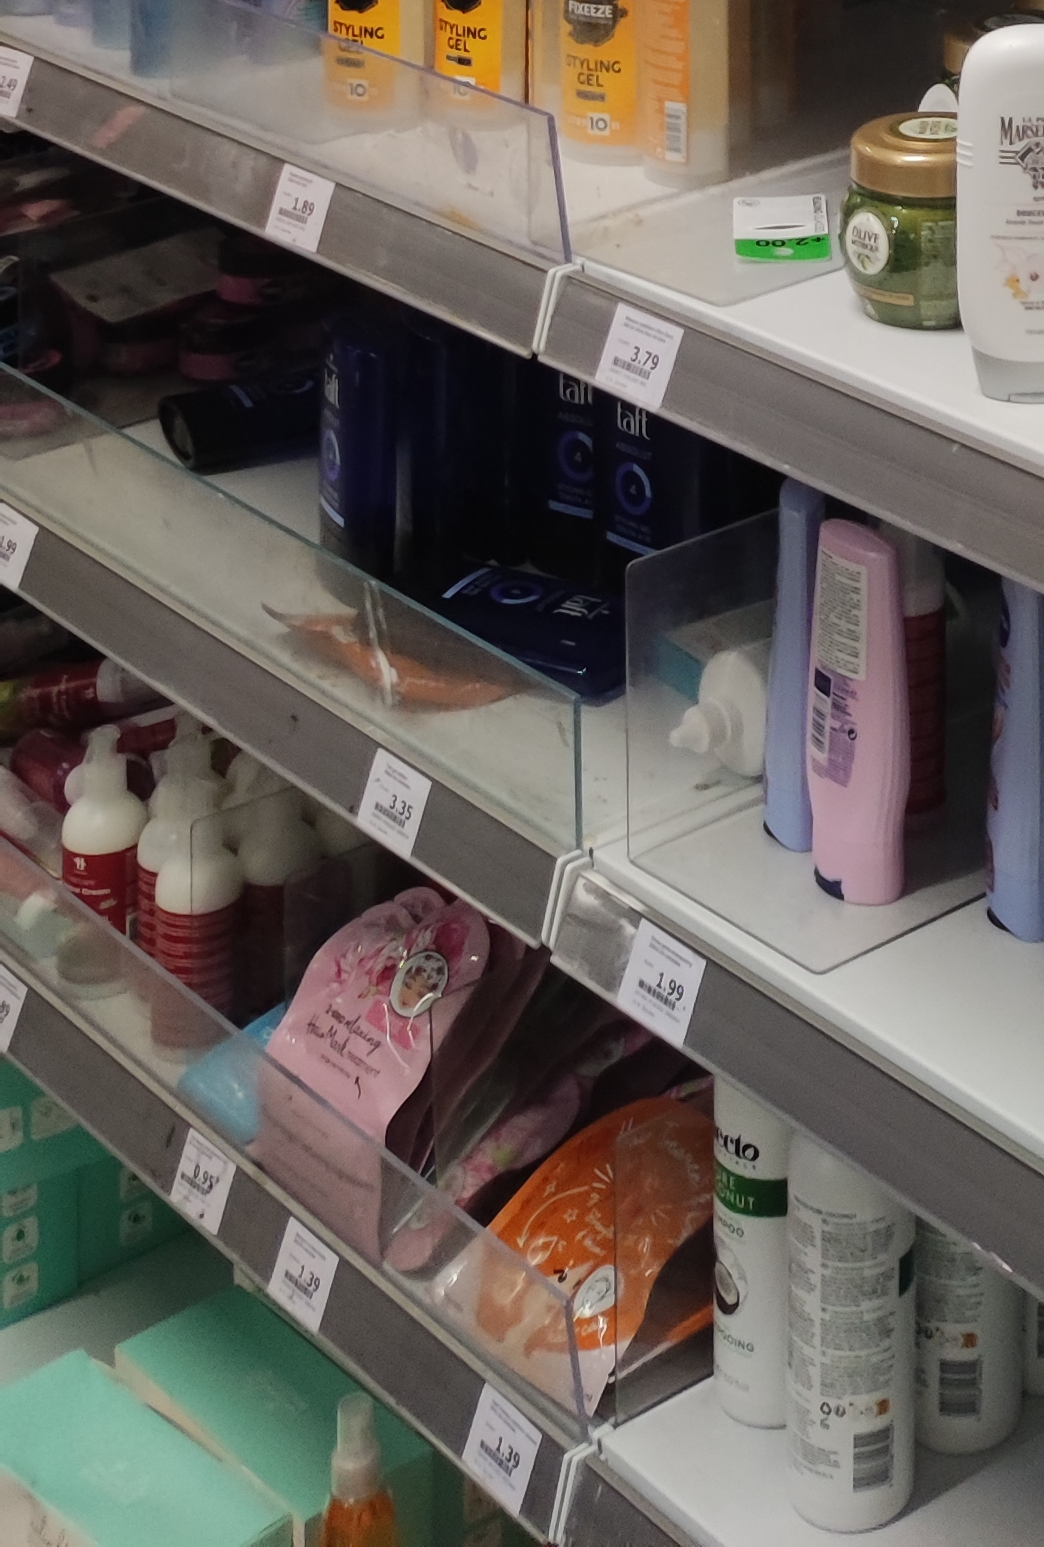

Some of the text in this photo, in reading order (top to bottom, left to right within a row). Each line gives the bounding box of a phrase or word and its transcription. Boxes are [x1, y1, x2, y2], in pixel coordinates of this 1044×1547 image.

[568, 0, 613, 19] FIXEEZE
[332, 19, 385, 40] STYLING
[438, 17, 488, 40] STYLING
[446, 36, 471, 53] GEL
[565, 53, 622, 75] STYLING
[349, 81, 367, 97] 10
[577, 72, 604, 88] GEL
[589, 116, 608, 132] 10
[291, 197, 316, 218] 1.89
[851, 225, 880, 246] OLIVE
[630, 345, 661, 373] 3.79
[615, 400, 651, 441] taft
[389, 793, 414, 821] 3.35
[656, 971, 685, 1003] 1.99
